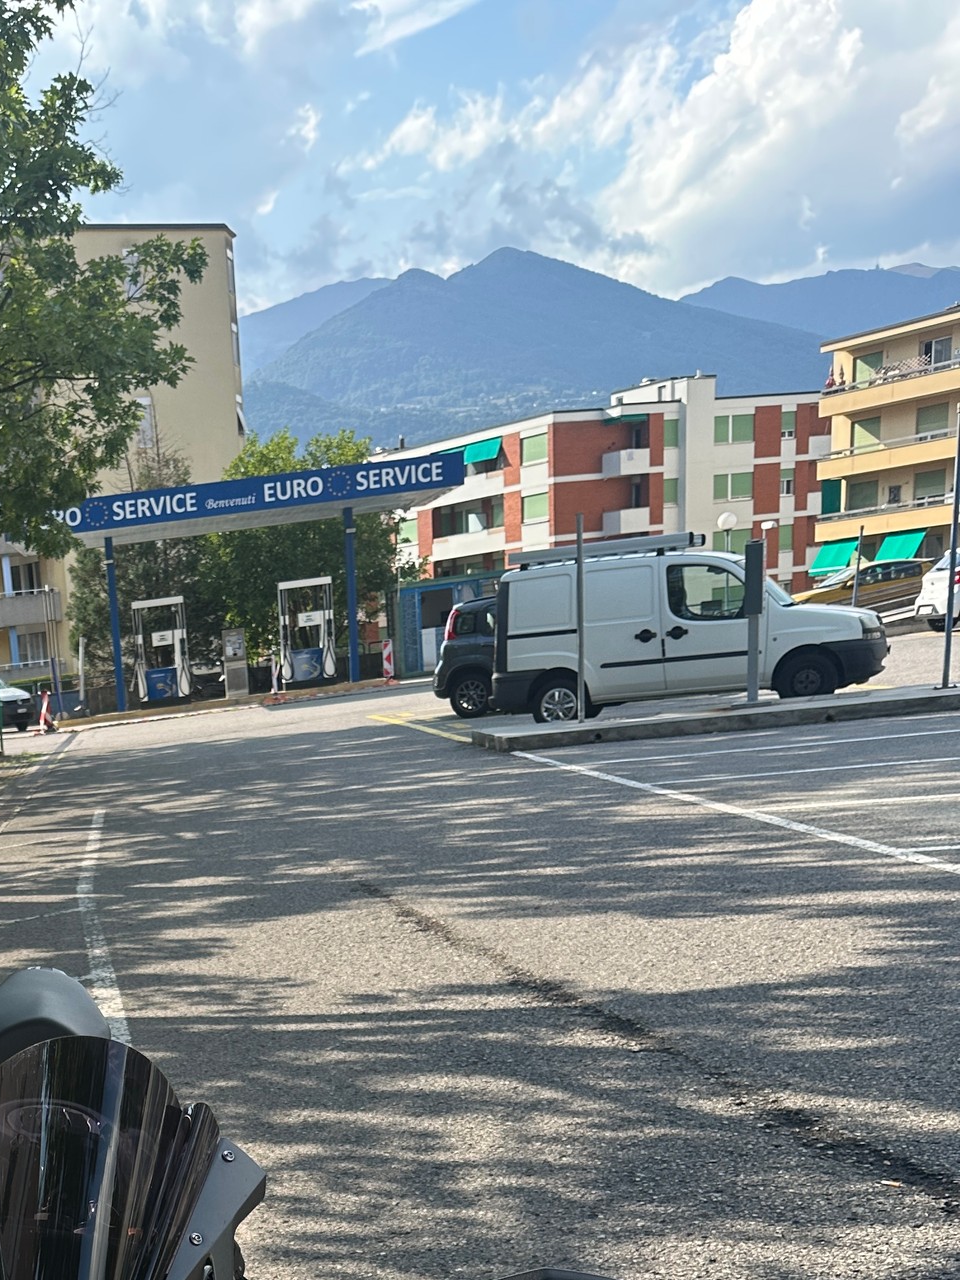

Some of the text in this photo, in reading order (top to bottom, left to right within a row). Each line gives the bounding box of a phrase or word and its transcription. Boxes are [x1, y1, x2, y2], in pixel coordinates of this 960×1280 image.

[112, 492, 198, 521] SERVICE
[205, 493, 256, 509] Benvenuti
[263, 476, 324, 502] EURO
[356, 461, 443, 491] SERVICE
